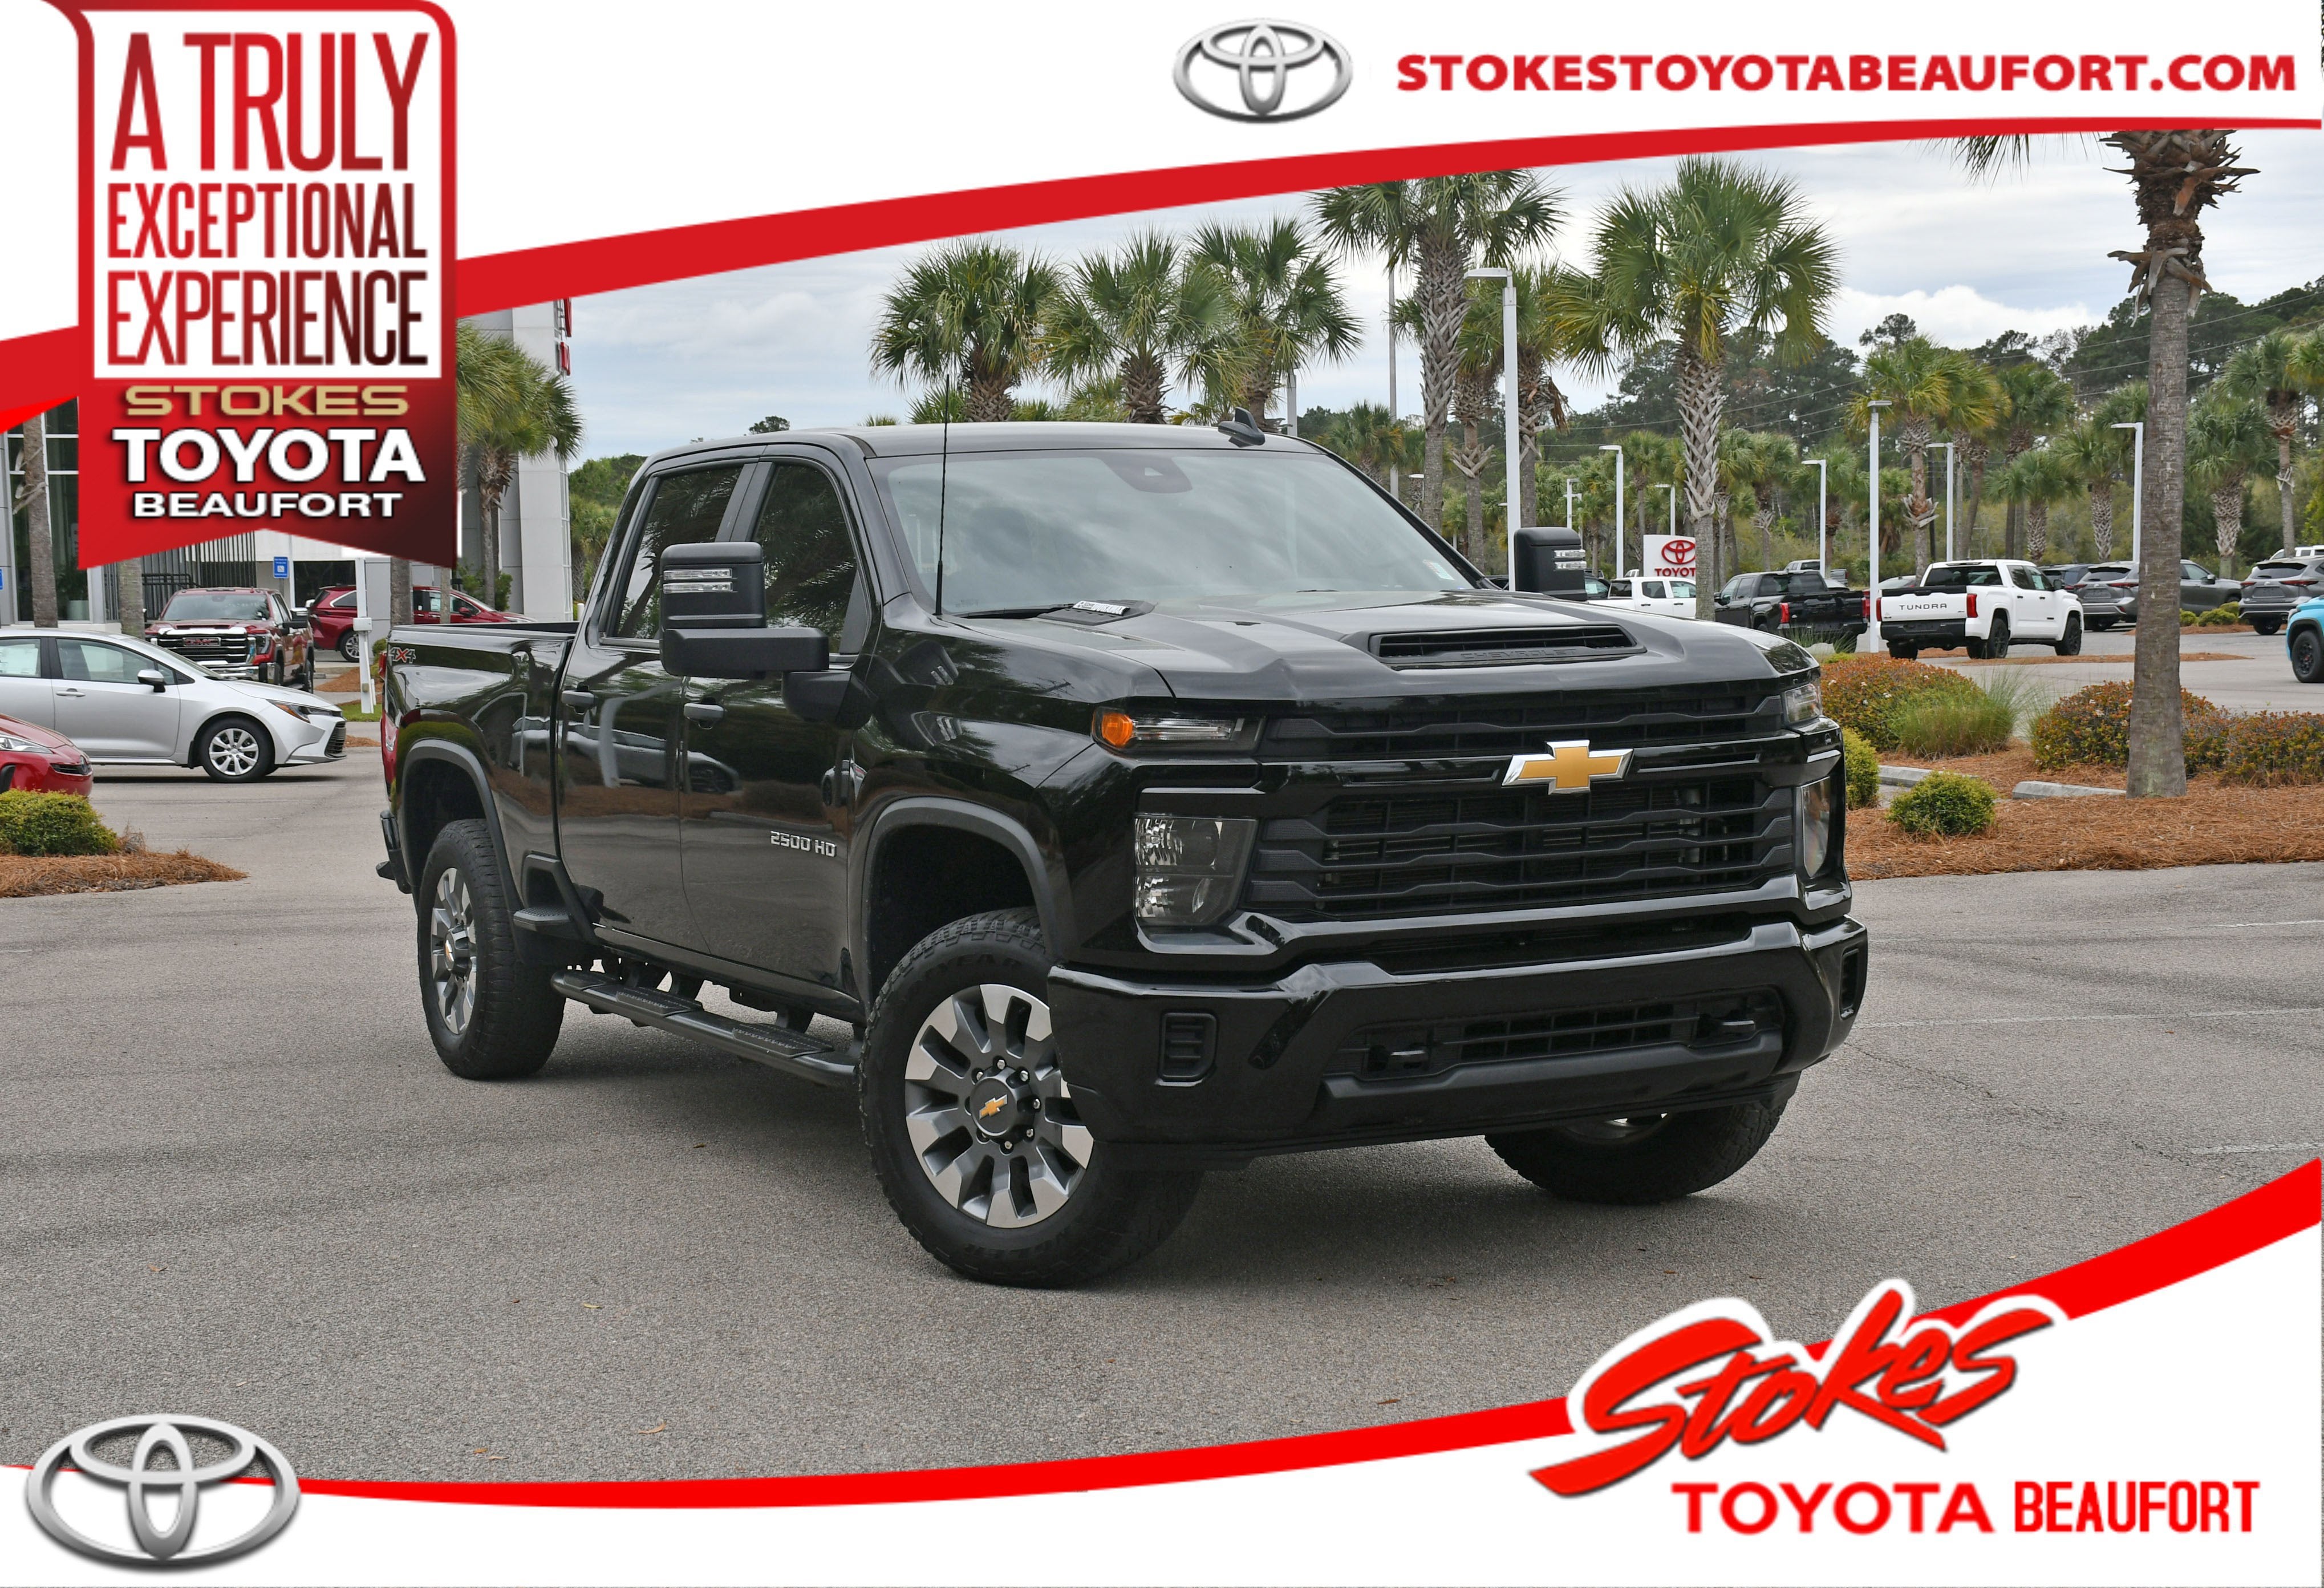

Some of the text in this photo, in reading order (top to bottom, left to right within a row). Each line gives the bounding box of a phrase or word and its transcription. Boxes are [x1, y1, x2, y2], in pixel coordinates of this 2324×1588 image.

[1654, 567, 1696, 577] TOYOT
[1461, 648, 1576, 659] CHEVROLET
[770, 831, 837, 857] 2500 HD
